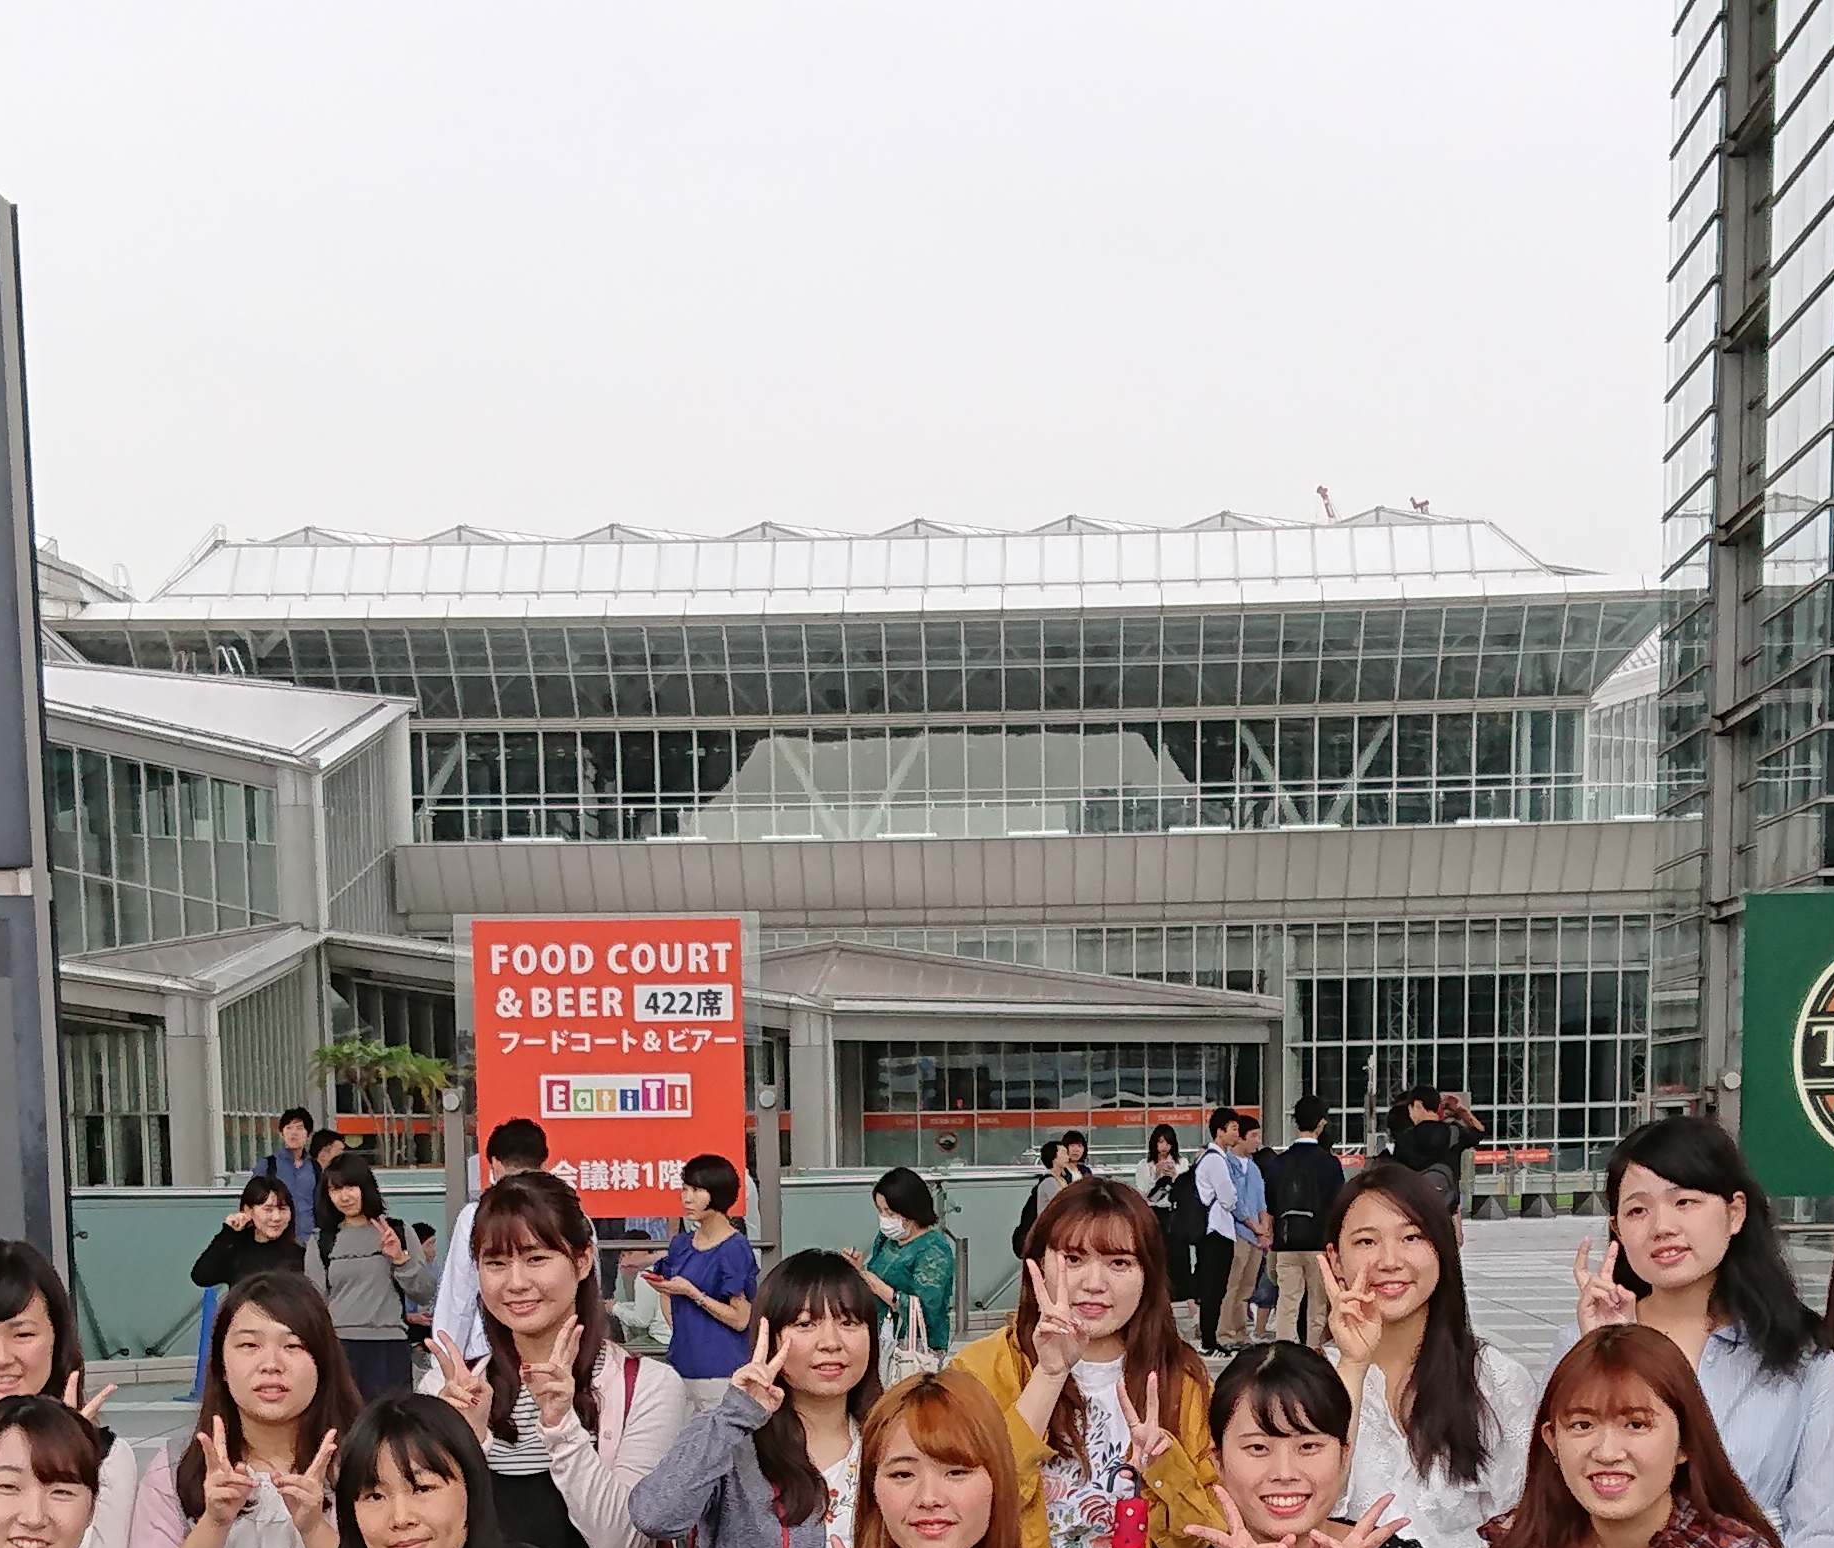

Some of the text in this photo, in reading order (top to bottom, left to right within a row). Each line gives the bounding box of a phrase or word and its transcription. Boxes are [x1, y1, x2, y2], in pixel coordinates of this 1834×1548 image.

[490, 942, 733, 975] FOOD COURT
[495, 986, 725, 1018] & BEER 422席
[497, 1027, 738, 1054] フードコート&ビアー
